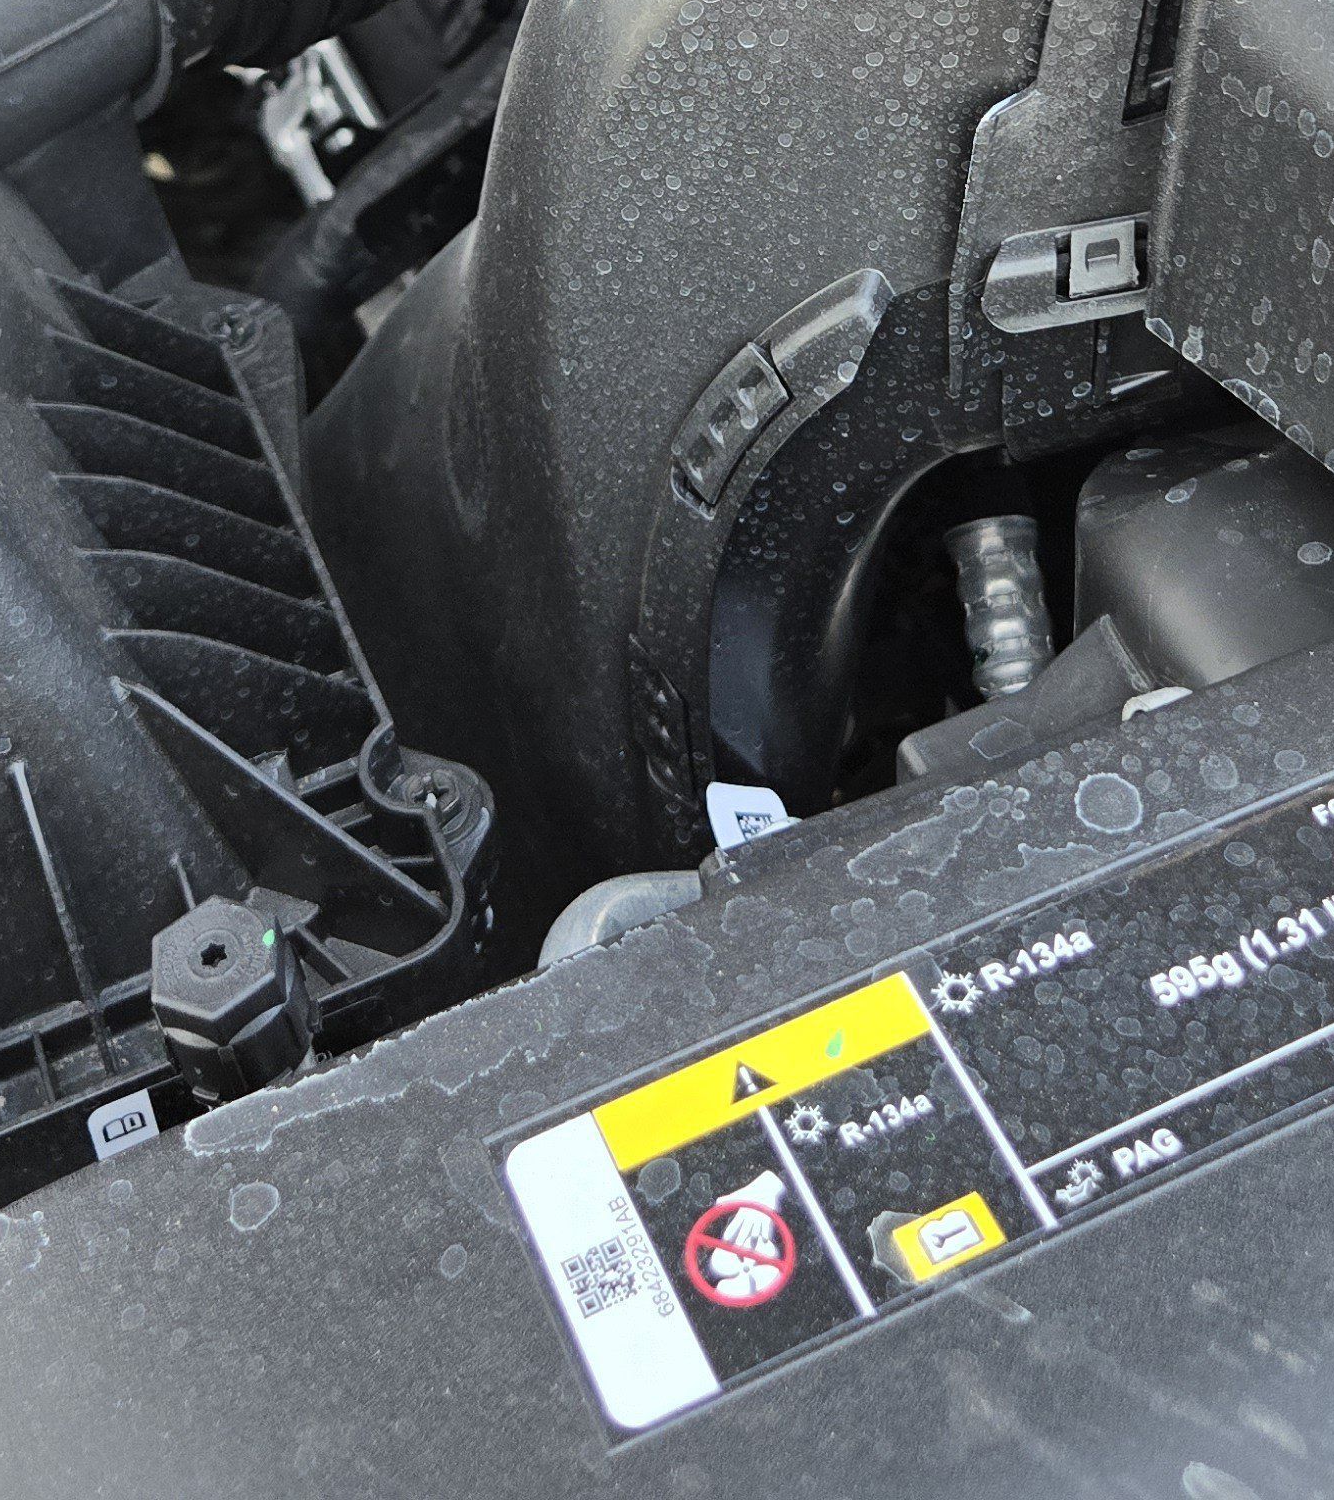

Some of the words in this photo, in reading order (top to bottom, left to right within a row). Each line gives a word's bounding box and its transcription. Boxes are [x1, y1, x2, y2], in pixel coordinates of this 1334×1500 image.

[978, 930, 1096, 993] R-134a
[1148, 949, 1246, 1008] 595g
[1238, 907, 1327, 971] (1.31
[837, 1093, 933, 1148] R-134a
[1110, 1127, 1184, 1178] PAG
[609, 1196, 675, 1318] 68423291AB
